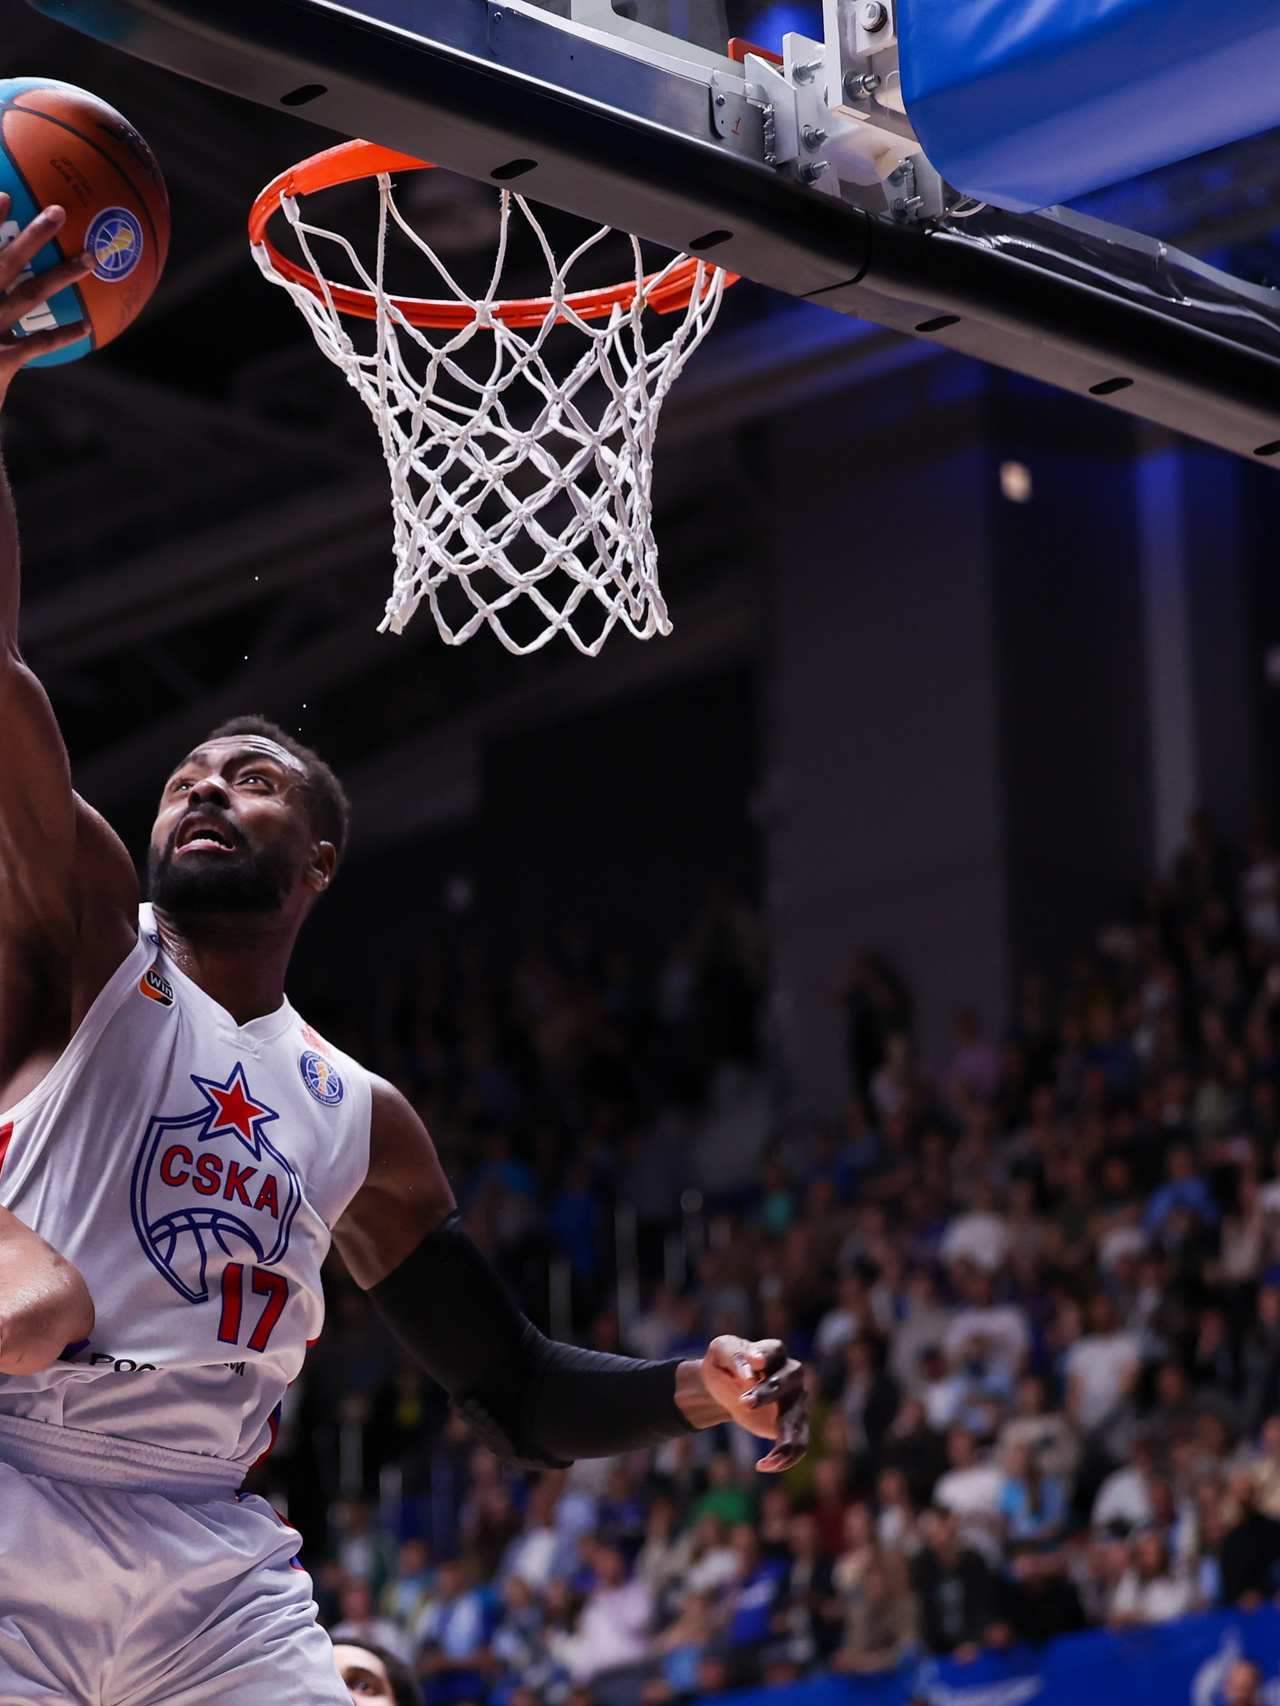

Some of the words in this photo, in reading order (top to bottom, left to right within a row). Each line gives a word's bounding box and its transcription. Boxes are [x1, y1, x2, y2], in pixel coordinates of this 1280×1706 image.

[149, 971, 173, 998] Win
[160, 1144, 279, 1220] CSKA
[217, 1262, 289, 1353] 17
